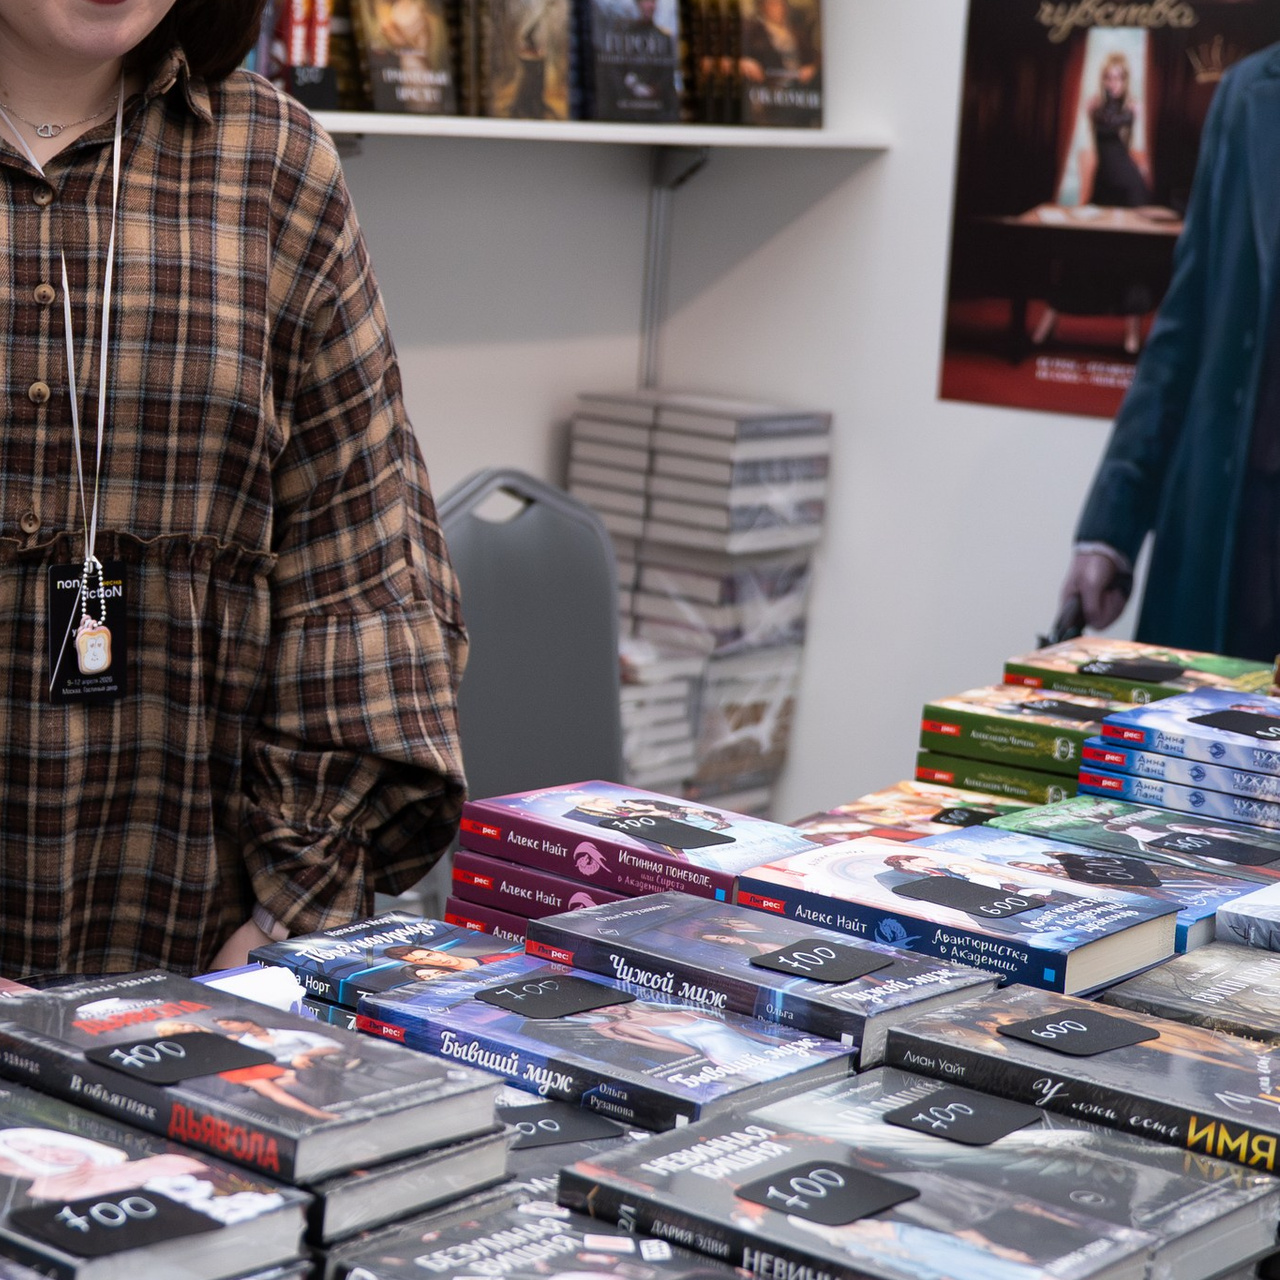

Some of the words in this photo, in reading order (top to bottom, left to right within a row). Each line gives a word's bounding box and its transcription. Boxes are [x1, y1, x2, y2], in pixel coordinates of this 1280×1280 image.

[56, 579, 80, 590] non
[507, 830, 539, 851] Алекс
[542, 839, 569, 858] Найт
[499, 880, 534, 902] Алекс
[535, 889, 563, 908] Найт
[979, 896, 1029, 917] 600
[795, 903, 834, 925] Алекс
[836, 914, 868, 934] Найт
[353, 922, 437, 954] награда
[492, 925, 526, 946] Алекс
[931, 928, 1029, 965] Авантюристка
[777, 946, 837, 973] 700
[950, 945, 1019, 973] Академии
[305, 975, 331, 995] Норт
[495, 980, 562, 1002] 700
[609, 952, 675, 997] Чужой
[676, 977, 728, 1009] муж
[765, 1002, 795, 1021] Ольга
[1031, 1020, 1088, 1040] 600
[108, 1039, 187, 1070] 700
[440, 1030, 519, 1078] Бывший
[521, 1060, 573, 1095] муж
[598, 1082, 629, 1101] Ольга
[589, 1093, 636, 1119] Рузанова
[903, 1049, 936, 1069] Лиан
[937, 1056, 967, 1076] Уайт
[1186, 1115, 1279, 1172] ИМЯ
[911, 1103, 974, 1131] 700
[70, 1073, 83, 1091] В
[83, 1081, 158, 1122] объятиях
[168, 1100, 281, 1172] ДЬЯВОЛА
[640, 1122, 778, 1176] НЕВИННАЯ
[692, 1140, 793, 1181] ВИШНЯ
[767, 1168, 846, 1209] 700
[55, 1195, 158, 1234] 700
[650, 1220, 695, 1246] ДАРИЯ
